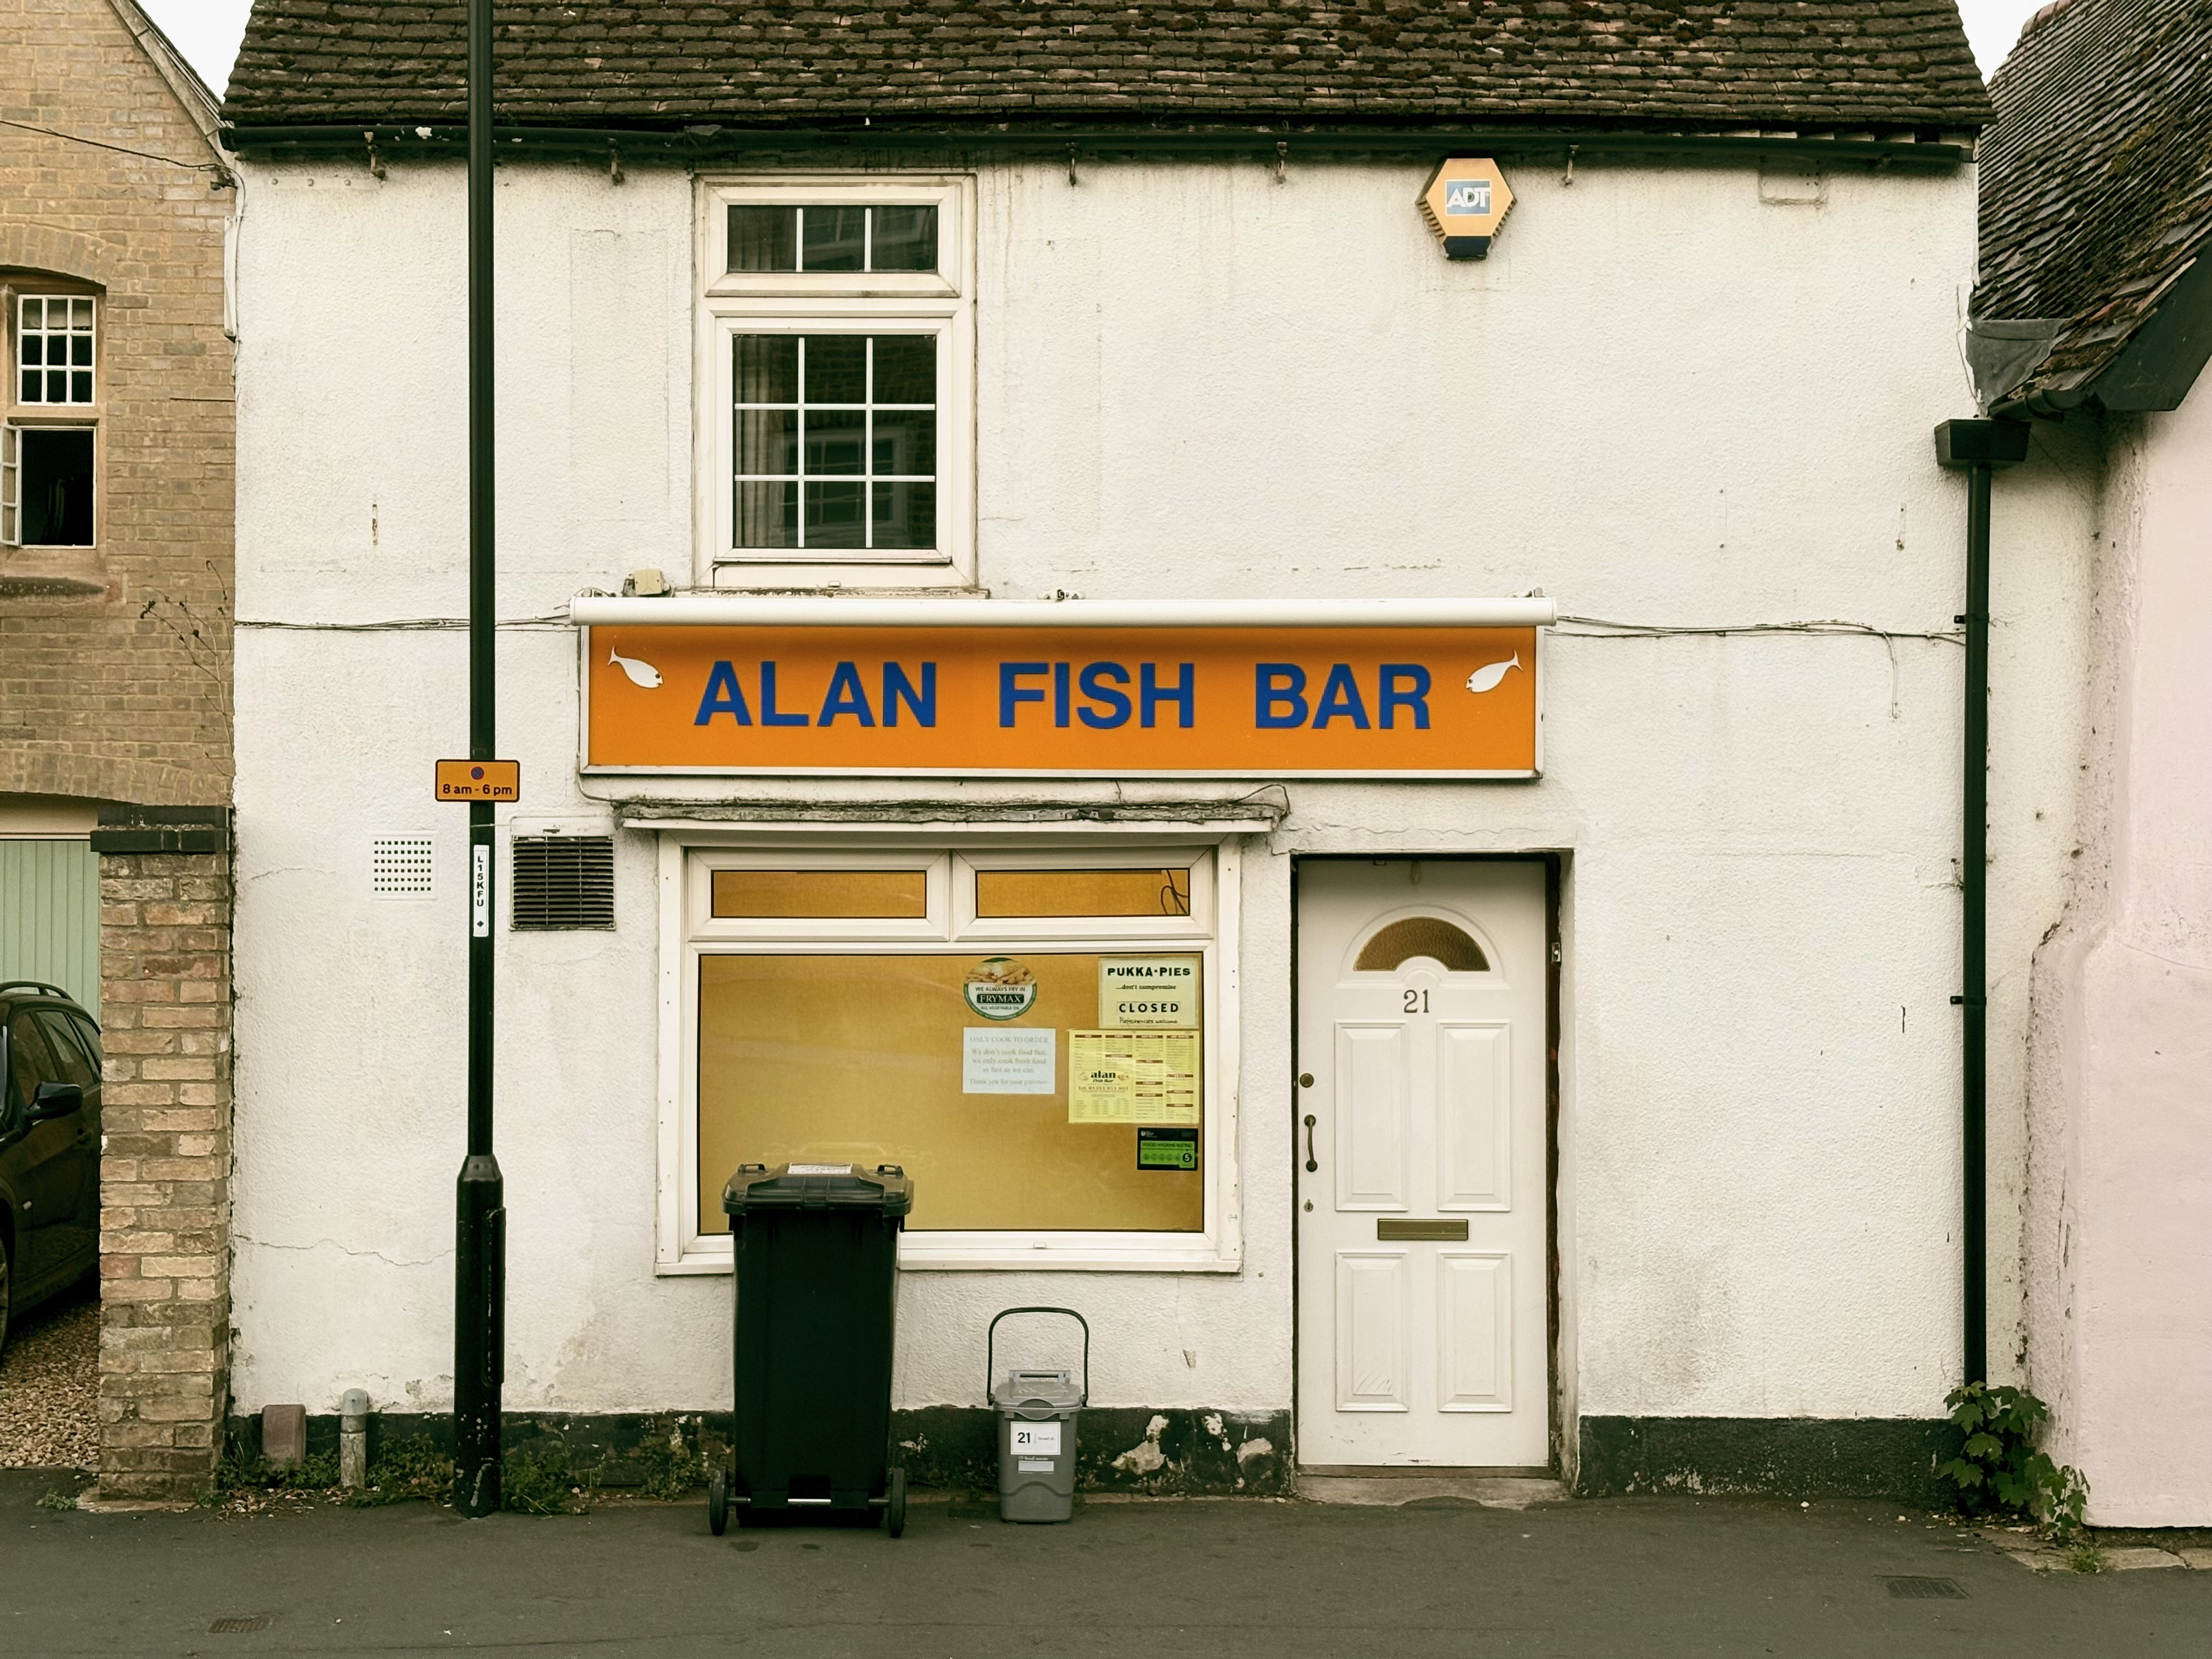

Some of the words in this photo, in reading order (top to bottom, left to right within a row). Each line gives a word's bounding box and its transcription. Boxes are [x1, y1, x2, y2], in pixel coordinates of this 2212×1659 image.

[1446, 187, 1491, 208] ADT
[693, 660, 936, 727] ALAN
[998, 661, 1195, 729] FISH
[1255, 662, 1432, 730] BAR
[443, 783, 451, 794] 8
[454, 786, 472, 795] am
[482, 784, 490, 795] 6
[494, 786, 512, 797] pm
[979, 994, 1021, 1003] FRYMAX
[1403, 989, 1430, 1013] 21
[1119, 1003, 1179, 1013] CLOSED
[1090, 1070, 1116, 1079] alan
[1017, 1432, 1030, 1444] 21
